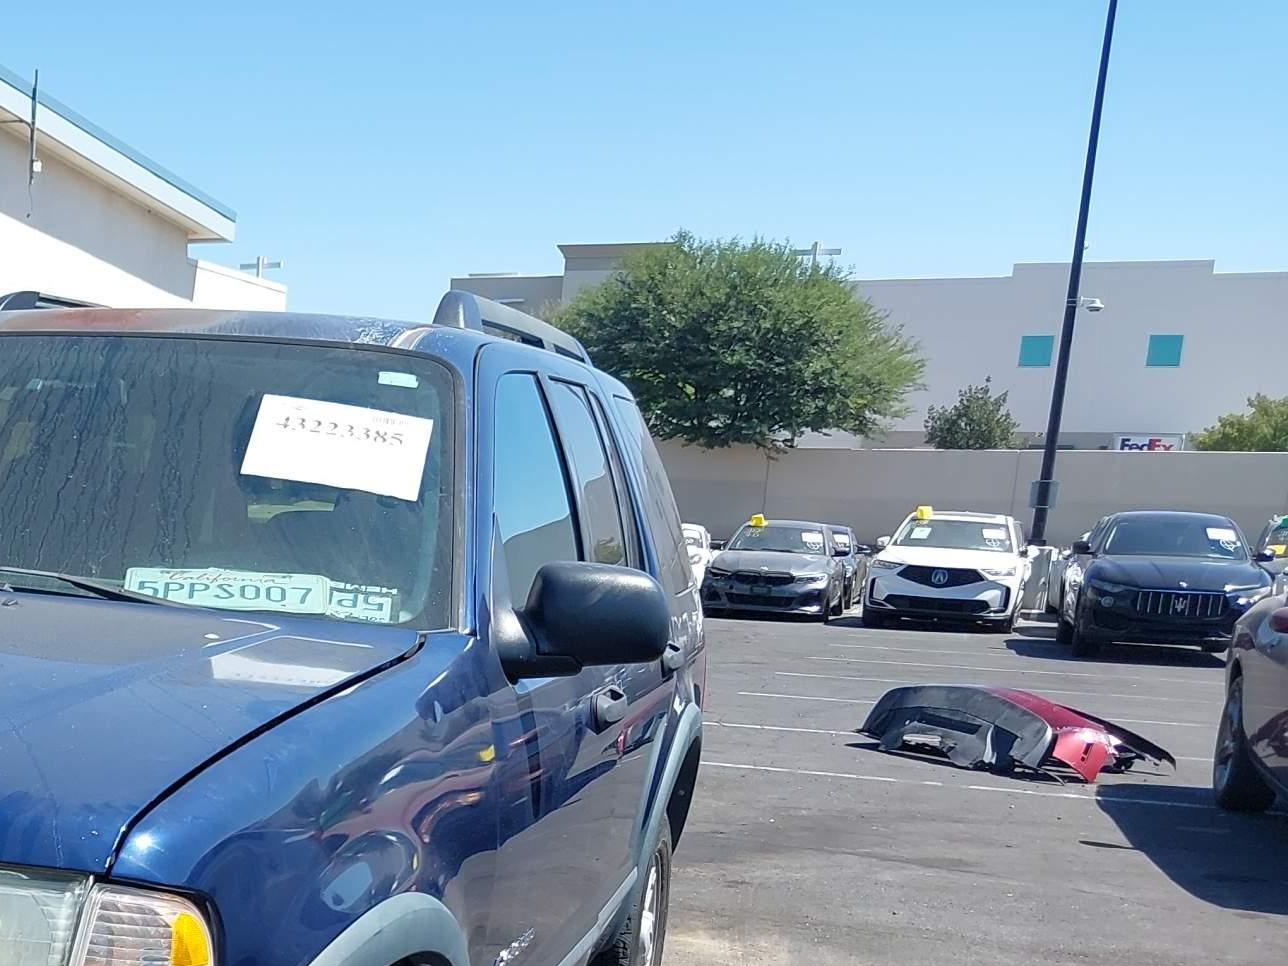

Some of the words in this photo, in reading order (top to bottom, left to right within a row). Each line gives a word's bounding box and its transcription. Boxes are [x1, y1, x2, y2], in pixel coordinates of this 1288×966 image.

[275, 415, 404, 446] 43223385
[168, 571, 276, 584] California
[138, 580, 312, 604] 5PPS007
